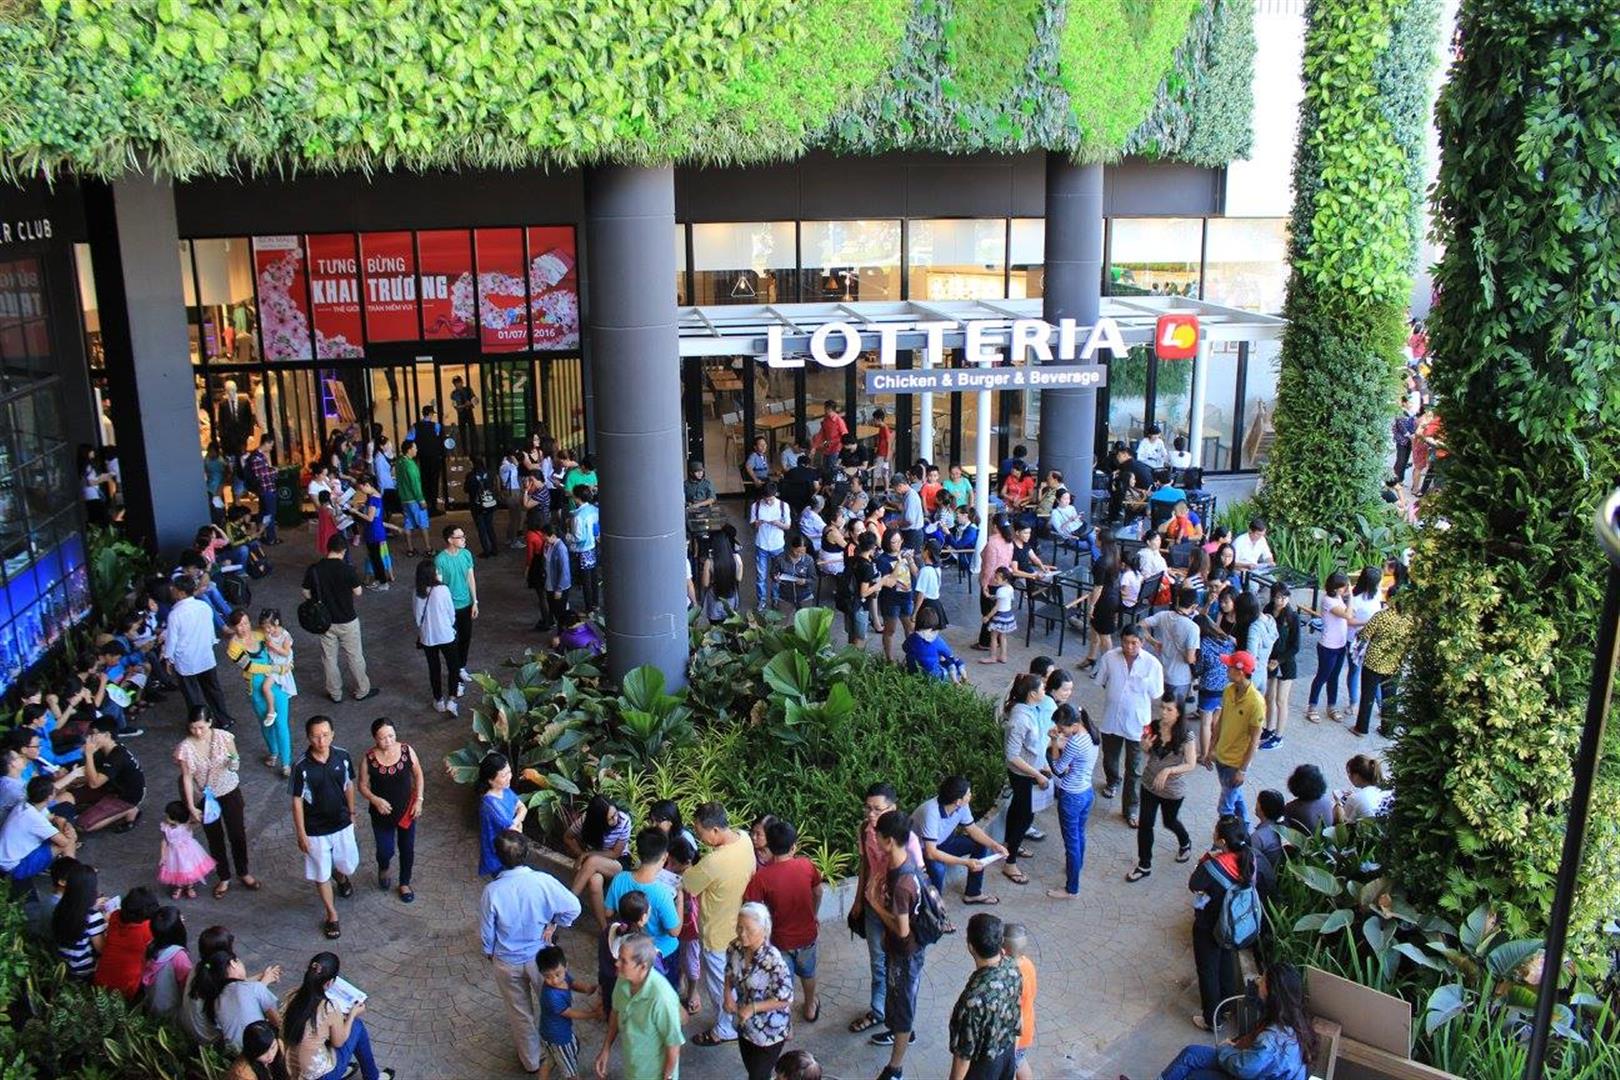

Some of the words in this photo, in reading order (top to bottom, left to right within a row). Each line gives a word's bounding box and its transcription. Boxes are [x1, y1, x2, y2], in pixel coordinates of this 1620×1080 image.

[0, 222, 12, 244] R
[17, 219, 52, 241] CLUB
[318, 259, 357, 274] TƯNG
[367, 254, 406, 273] BỪNG
[312, 279, 359, 304] KHAI
[767, 318, 1130, 369] LOTTERIA
[873, 374, 937, 389] Chicken
[941, 374, 953, 387] &
[957, 372, 1010, 388] Burger
[1014, 372, 1025, 385] &
[1029, 370, 1100, 386] Beverage
